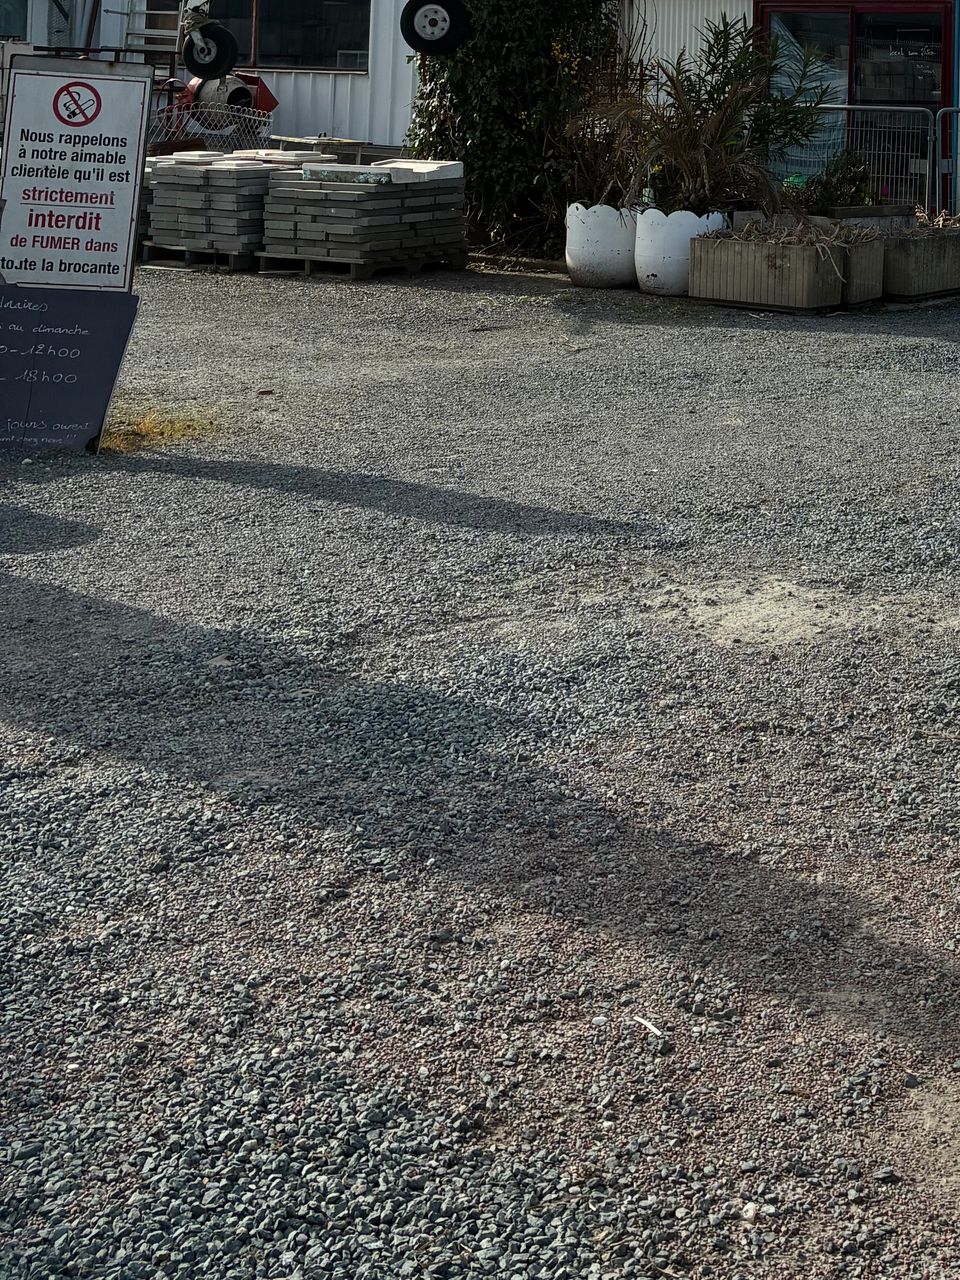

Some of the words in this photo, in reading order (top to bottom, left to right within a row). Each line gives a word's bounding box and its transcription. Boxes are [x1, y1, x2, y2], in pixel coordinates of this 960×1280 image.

[20, 128, 54, 143] Nous
[59, 133, 128, 148] rappelons
[18, 145, 26, 159] à
[31, 148, 67, 161] notre
[71, 150, 126, 165] aimable
[11, 164, 69, 180] clientèle
[73, 167, 104, 184] qu'il
[109, 170, 131, 183] est
[22, 186, 115, 206] strictement
[27, 209, 101, 231] interdit
[10, 234, 27, 248] de
[32, 236, 80, 251] FUMER
[85, 238, 118, 253] dans
[41, 258, 54, 272] la
[58, 259, 120, 275] brocante
